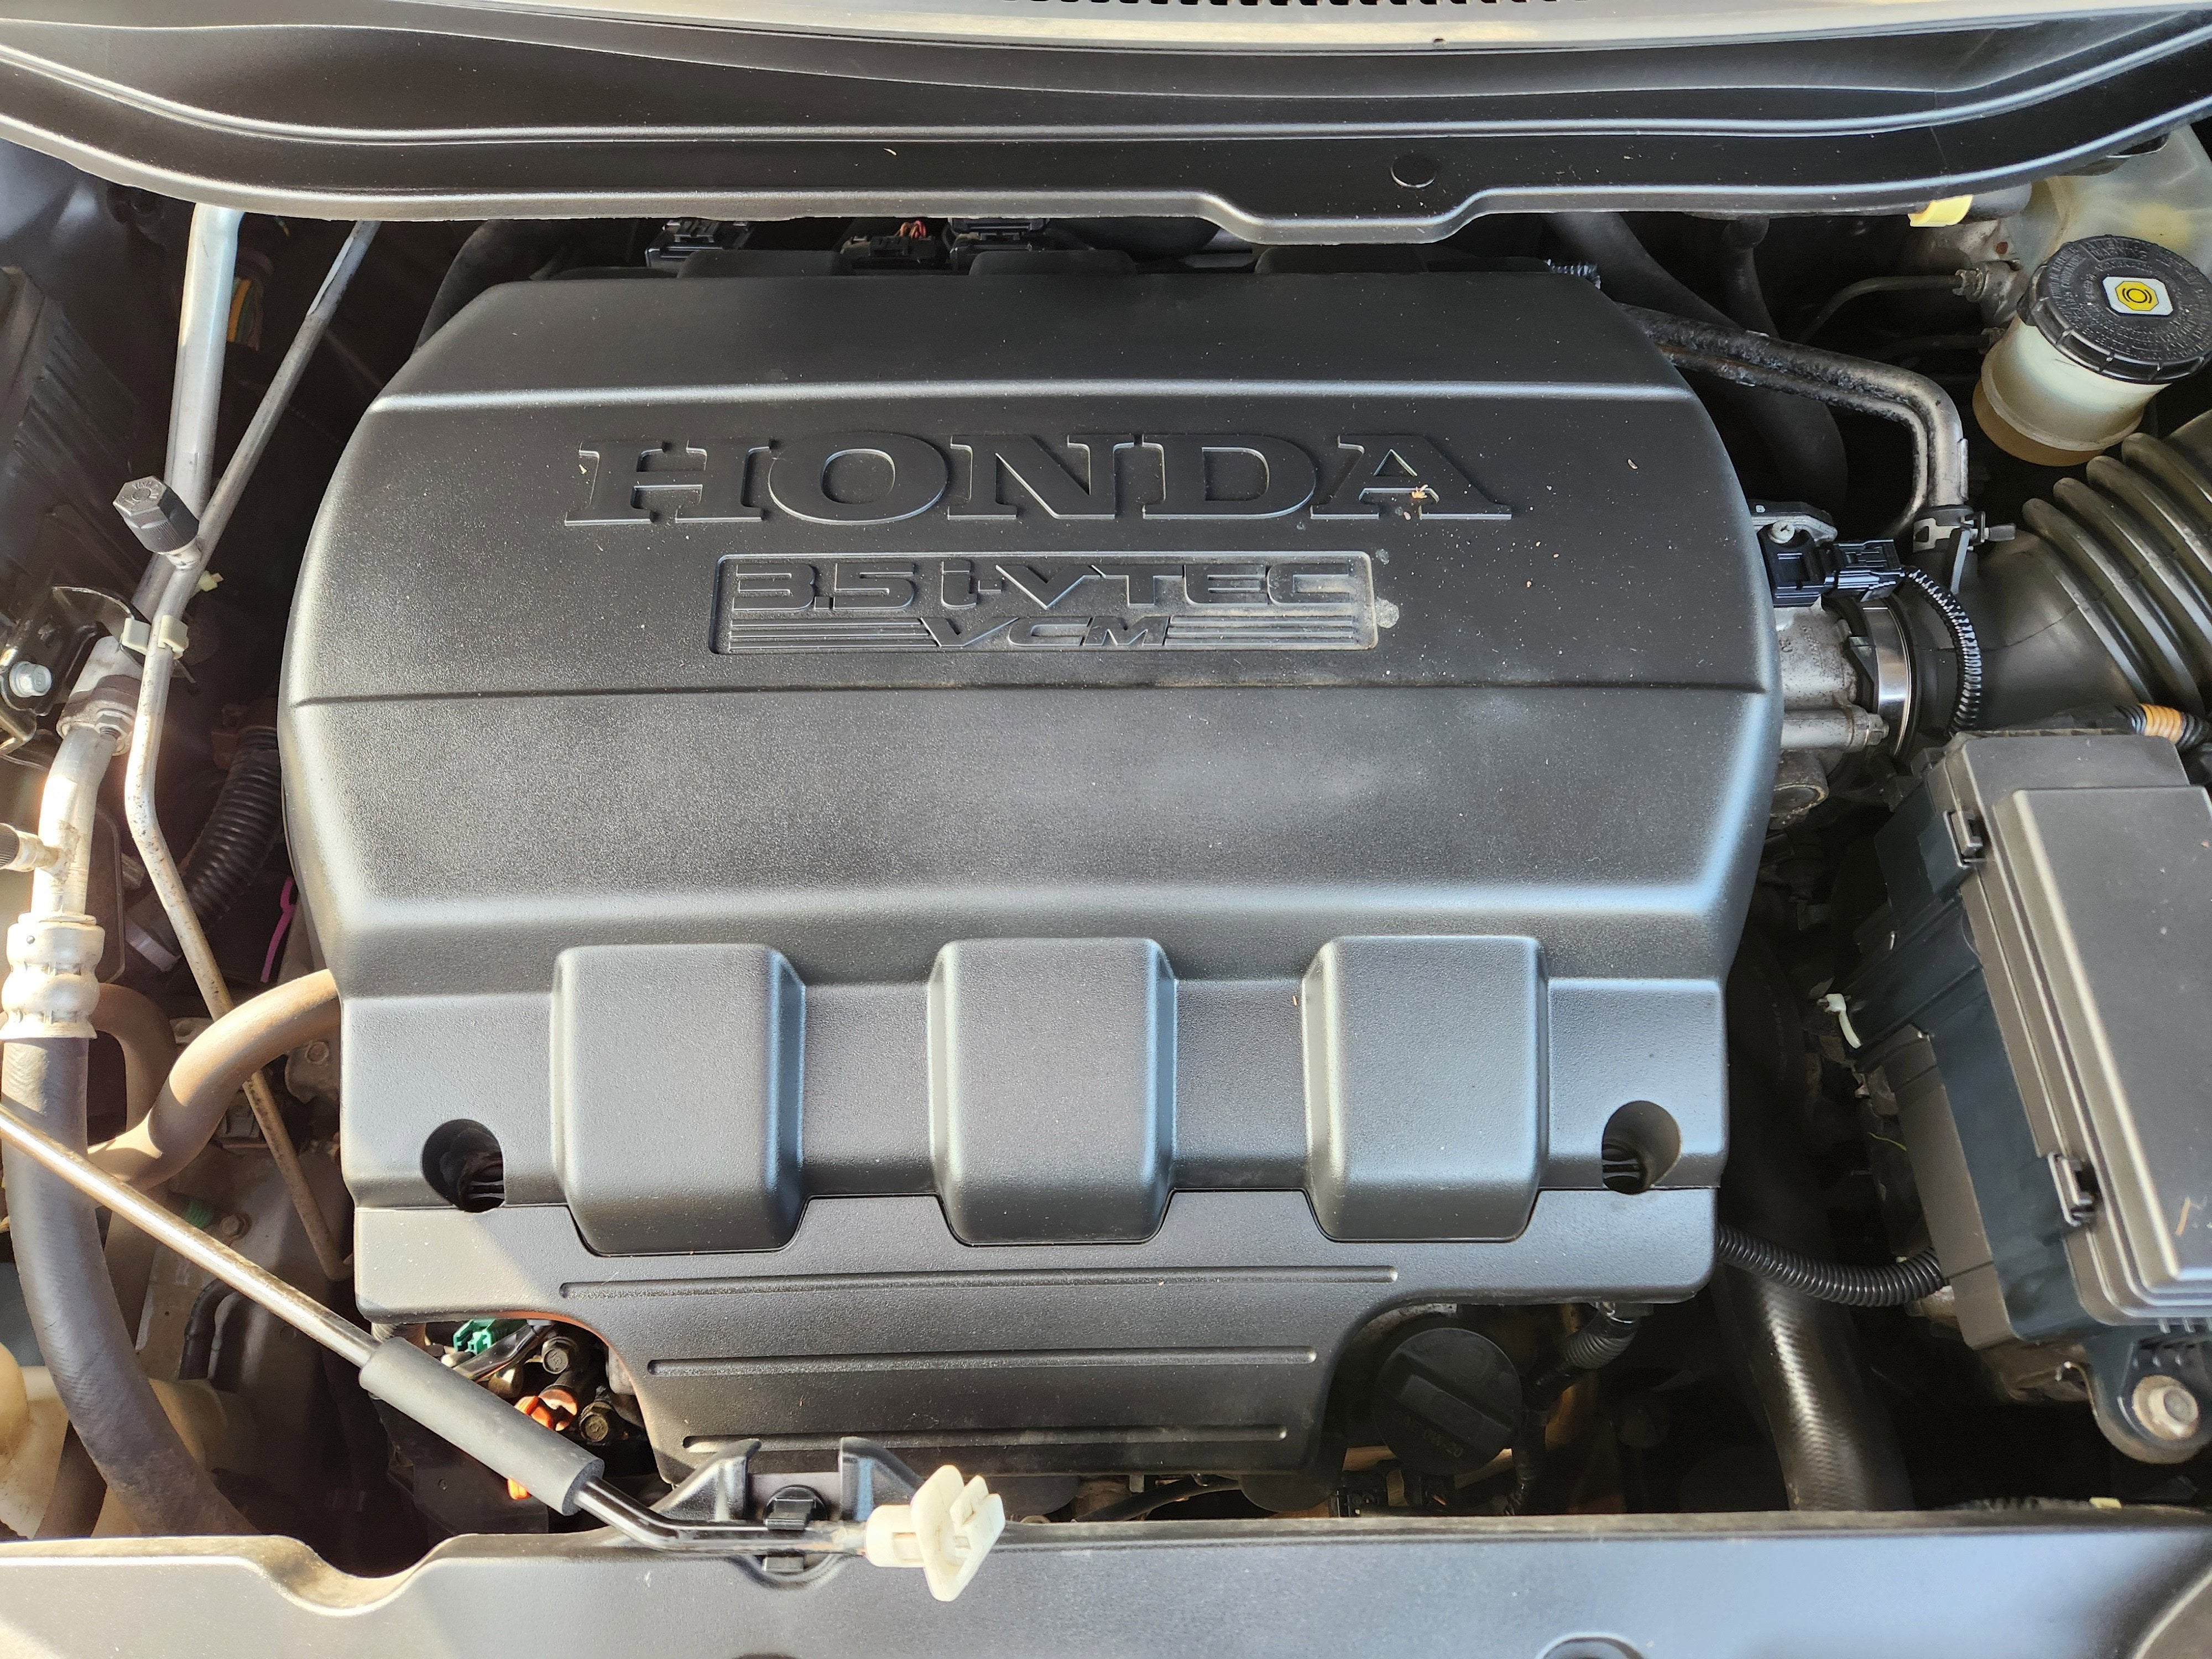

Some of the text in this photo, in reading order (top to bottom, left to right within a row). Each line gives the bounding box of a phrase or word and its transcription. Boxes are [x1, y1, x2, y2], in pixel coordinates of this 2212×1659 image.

[565, 433, 1512, 524] HONDA
[732, 559, 1353, 611] 3.5 i-VTEC
[920, 616, 1170, 648] VCM
